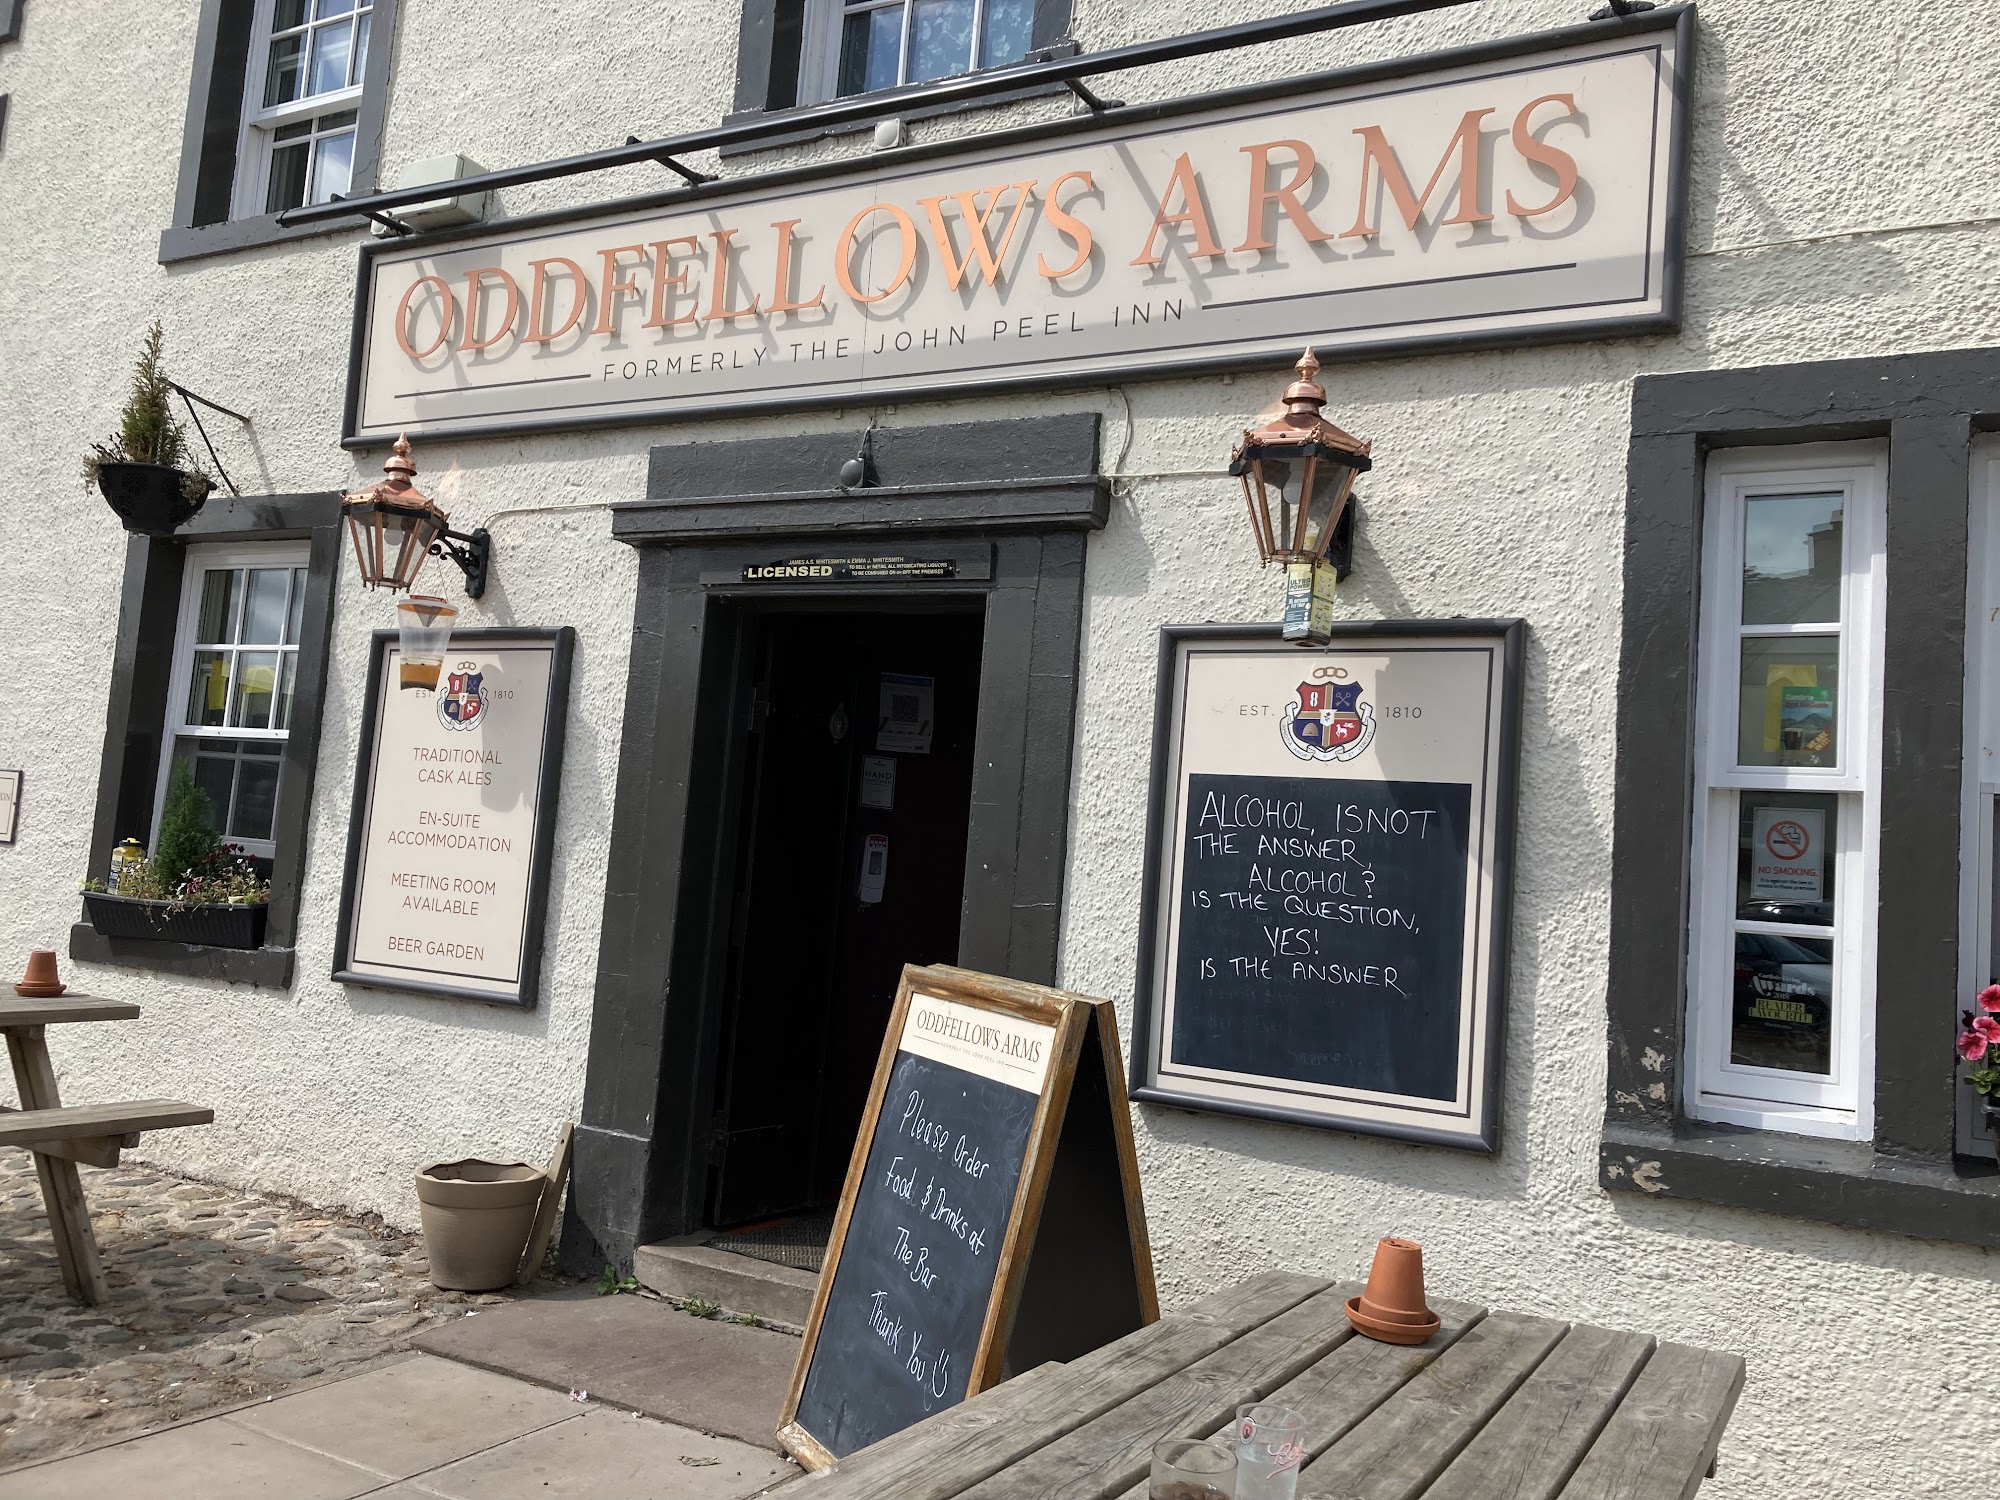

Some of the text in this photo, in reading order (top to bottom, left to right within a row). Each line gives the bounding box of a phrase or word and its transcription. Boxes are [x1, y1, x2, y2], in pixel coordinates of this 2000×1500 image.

[395, 93, 1578, 358] ODDFELLOWS ARMS
[603, 298, 1183, 382] FORMERLY THE JOHN PEEL INN
[748, 565, 832, 578] LICENSED
[415, 690, 514, 700] EST. 1810
[1240, 705, 1422, 720] EST. 1810
[1357, 731, 1373, 752] VERITAS
[413, 747, 502, 765] TRADITIONAL
[418, 769, 492, 786] CASK ALES
[865, 770, 892, 779] HAND
[419, 811, 481, 829] EN-SUITE
[1199, 790, 1315, 835] ALCOHOL,
[388, 831, 511, 853] ACCOMMODATION
[1193, 832, 1240, 856] THE
[1773, 867, 1818, 876] SMOKING.
[391, 873, 496, 895] MEETING ROOM
[402, 895, 479, 916] AVAILABLE
[1192, 890, 1421, 935] IS THE QUESTION,
[388, 936, 484, 962] BEER GARDEN
[1264, 926, 1320, 957] YES!
[1200, 957, 1406, 997] IS THE ANSWER
[1758, 1000, 1803, 1012] READER
[917, 1009, 1042, 1063] ODDFELLOWS ARMS
[940, 1042, 962, 1052] FORMERLY
[899, 1090, 990, 1180] Please Order
[885, 1157, 913, 1199] Food
[931, 1187, 969, 1237] Drinks
[969, 1228, 985, 1255] at
[892, 1226, 938, 1292] The Bar
[869, 1289, 925, 1382] Thank You
